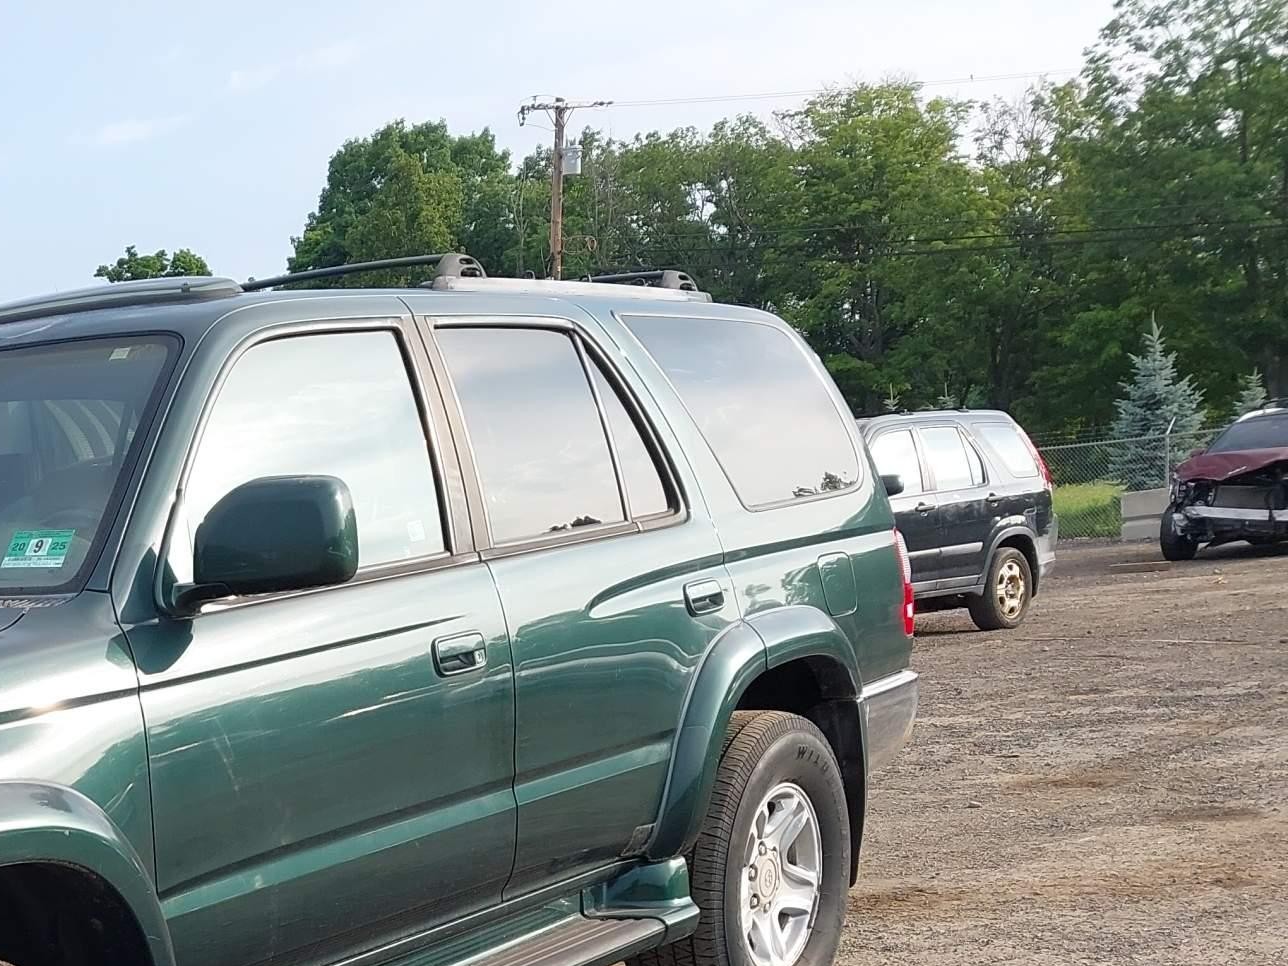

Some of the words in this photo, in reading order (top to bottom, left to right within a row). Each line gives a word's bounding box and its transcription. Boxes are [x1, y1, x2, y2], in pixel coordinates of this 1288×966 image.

[11, 542, 26, 552] 20
[33, 539, 44, 553] 9
[51, 541, 66, 551] 25
